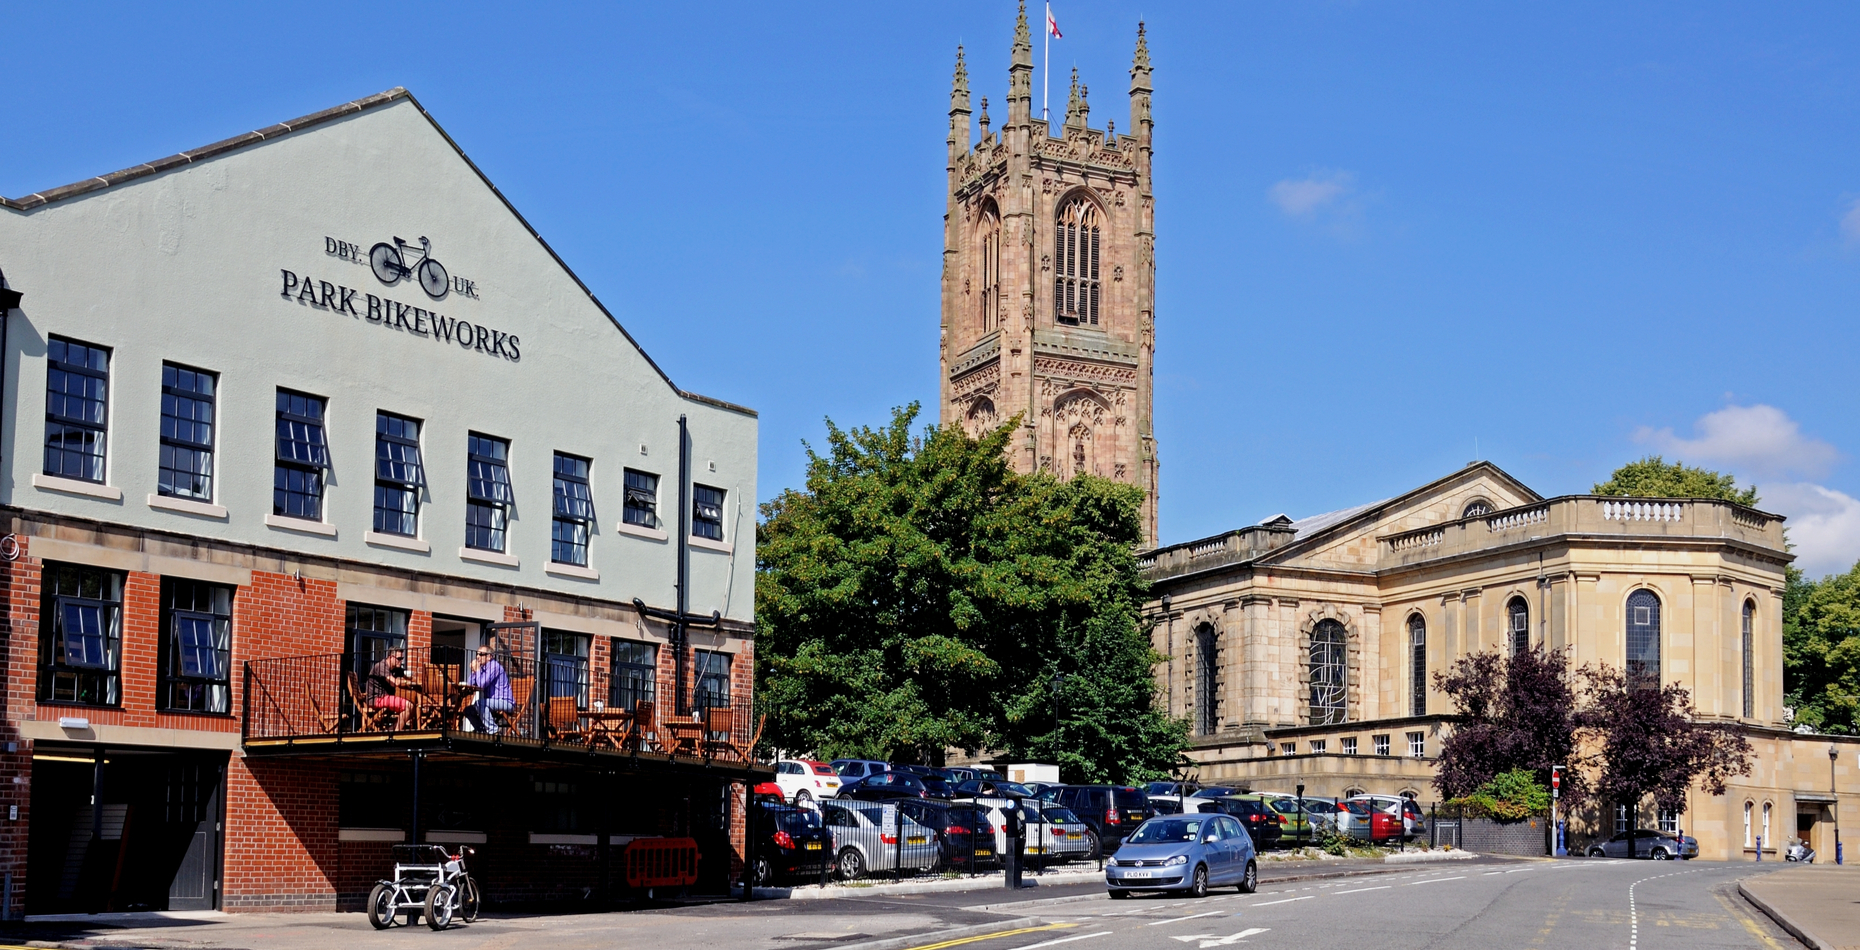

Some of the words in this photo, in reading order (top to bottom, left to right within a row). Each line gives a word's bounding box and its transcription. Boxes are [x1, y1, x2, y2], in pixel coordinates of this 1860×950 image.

[325, 236, 362, 262] DBY.
[453, 275, 479, 298] UK.
[281, 269, 357, 315] PARK
[366, 293, 520, 360] BIKEWORKS
